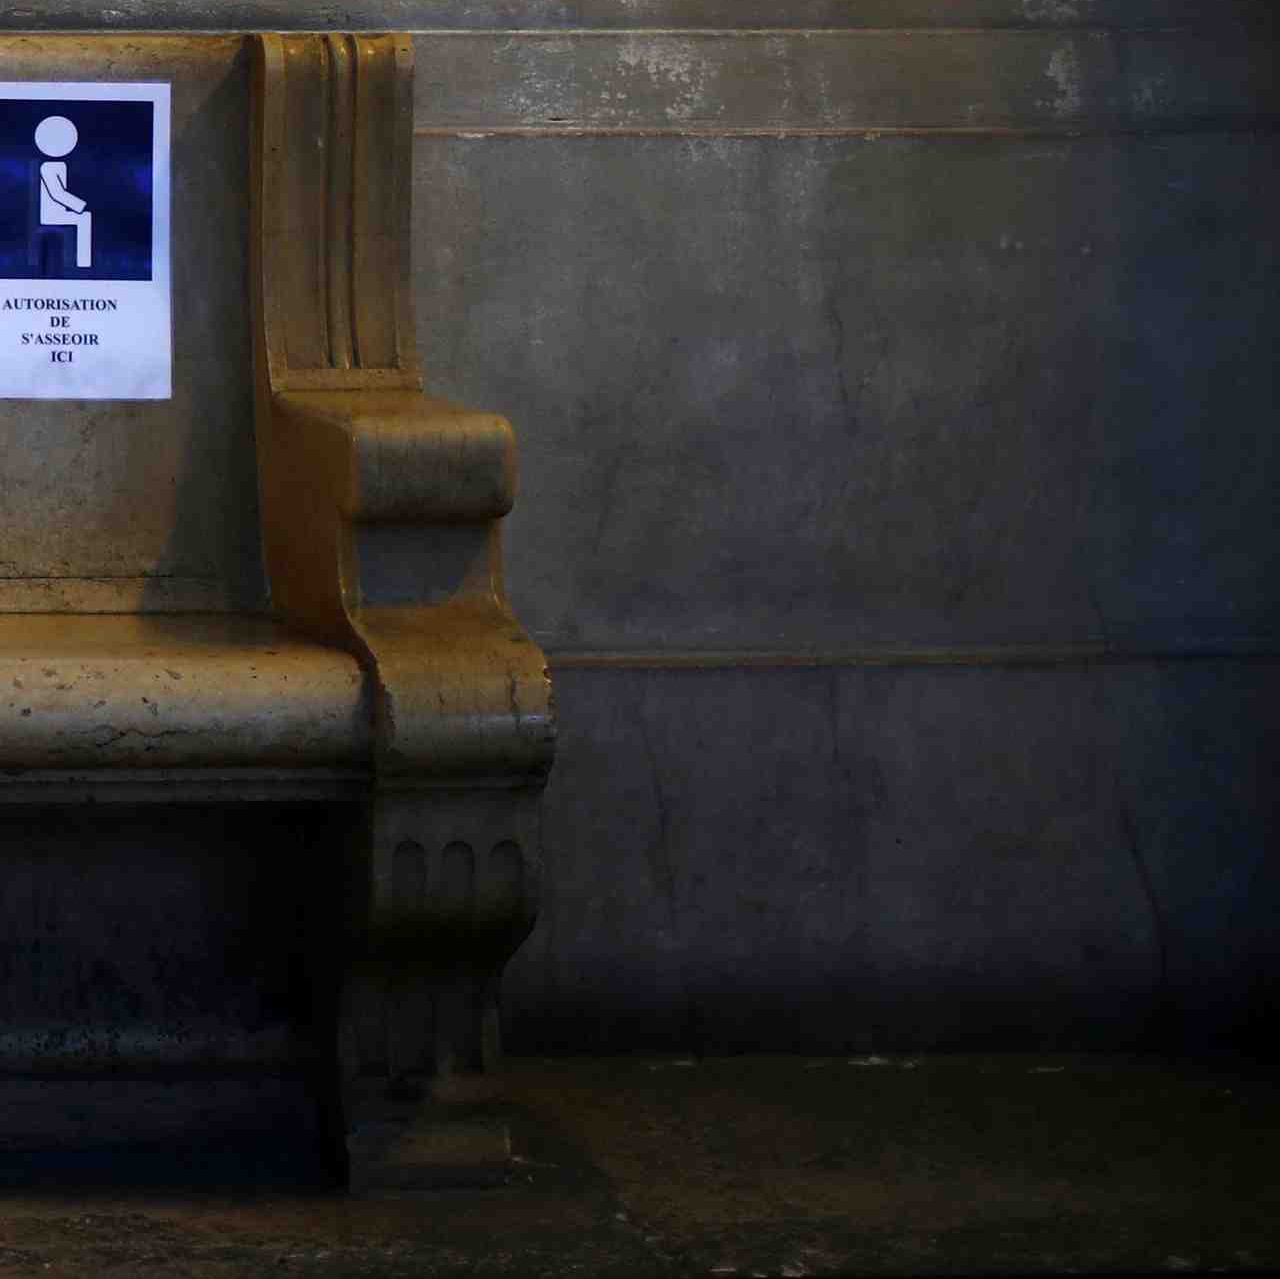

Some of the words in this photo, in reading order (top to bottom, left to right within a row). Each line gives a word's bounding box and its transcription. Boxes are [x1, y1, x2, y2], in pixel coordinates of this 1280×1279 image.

[2, 298, 118, 311] AUTORISATION
[50, 316, 71, 328] DE
[21, 333, 100, 346] S'ASSEOIR
[51, 350, 73, 363] ICI
